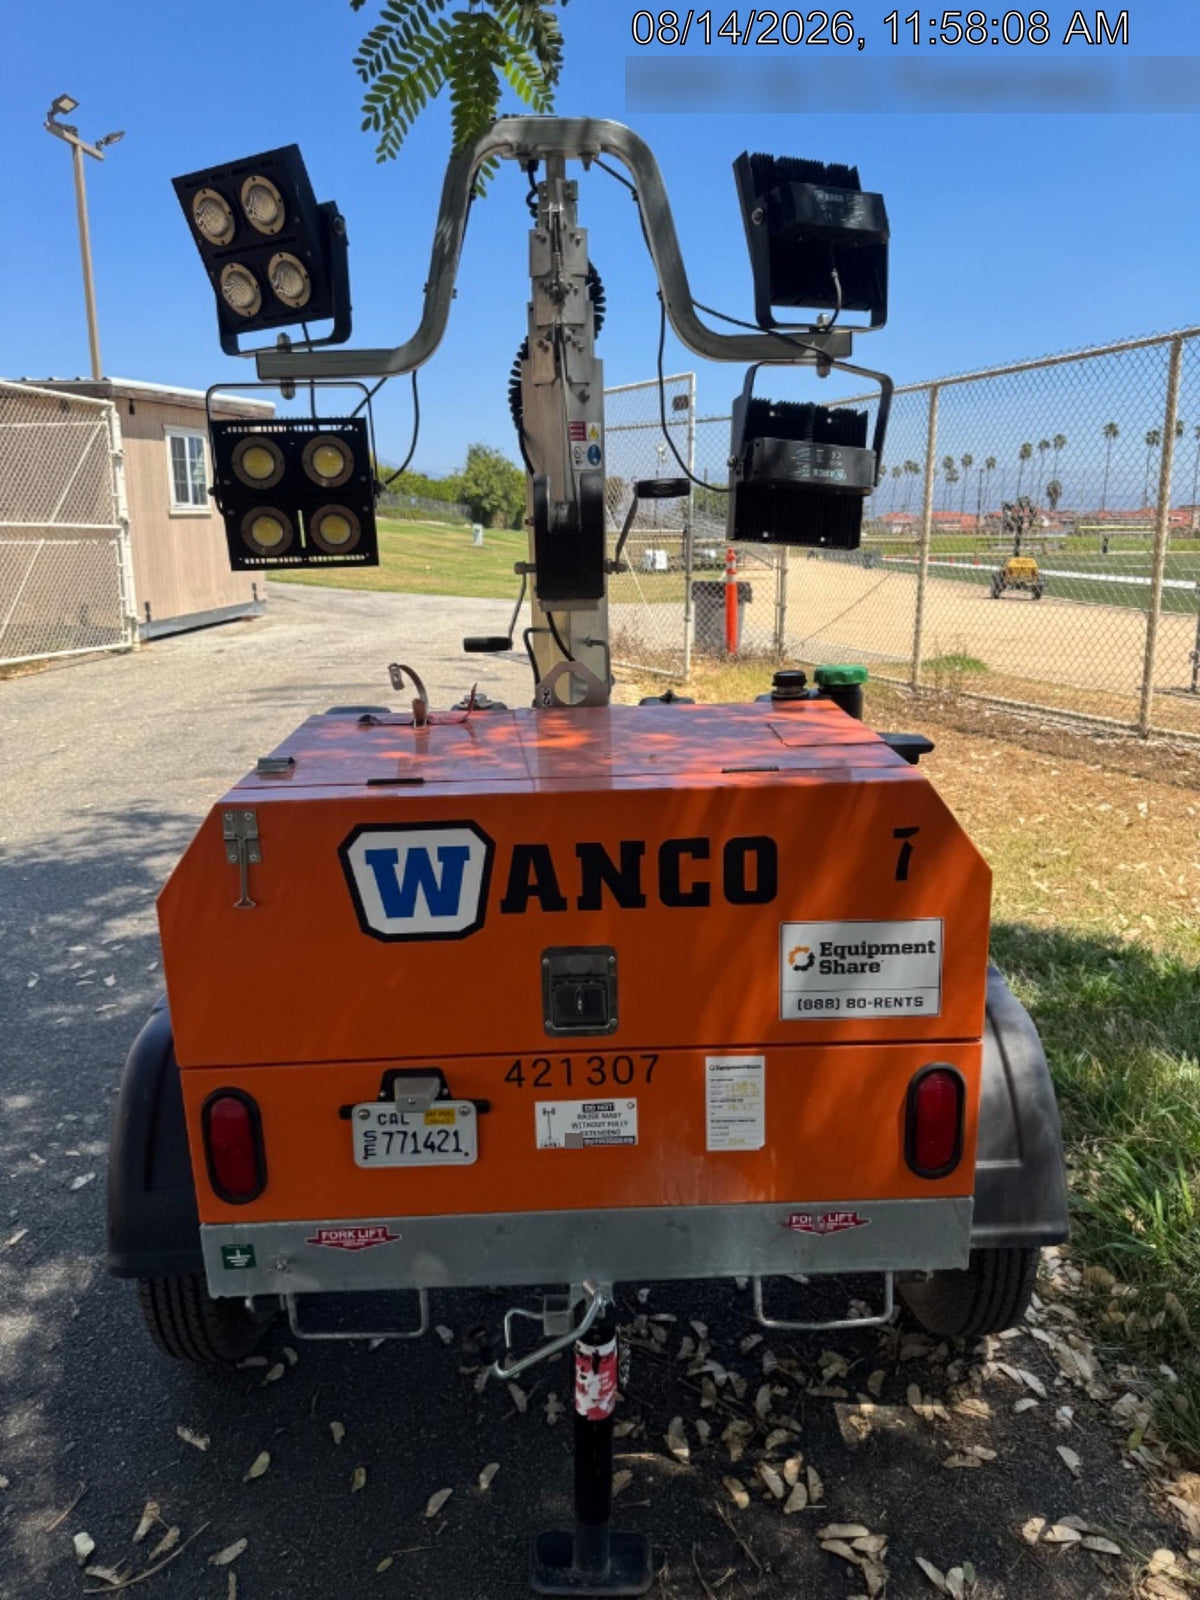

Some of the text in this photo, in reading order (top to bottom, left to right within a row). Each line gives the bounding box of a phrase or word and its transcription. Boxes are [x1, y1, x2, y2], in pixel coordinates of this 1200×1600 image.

[364, 834, 778, 919] WANCO
[819, 940, 936, 960] Equipment
[819, 960, 881, 975] Share
[798, 997, 924, 1011] (888) 80-RENTS
[504, 1053, 659, 1088] 421307
[377, 1112, 410, 1126] CAL
[571, 1121, 605, 1129] WITHOUT
[381, 1129, 463, 1154] 771421
[828, 1213, 854, 1223] LIFT
[321, 1228, 384, 1240] FORK LIFT
